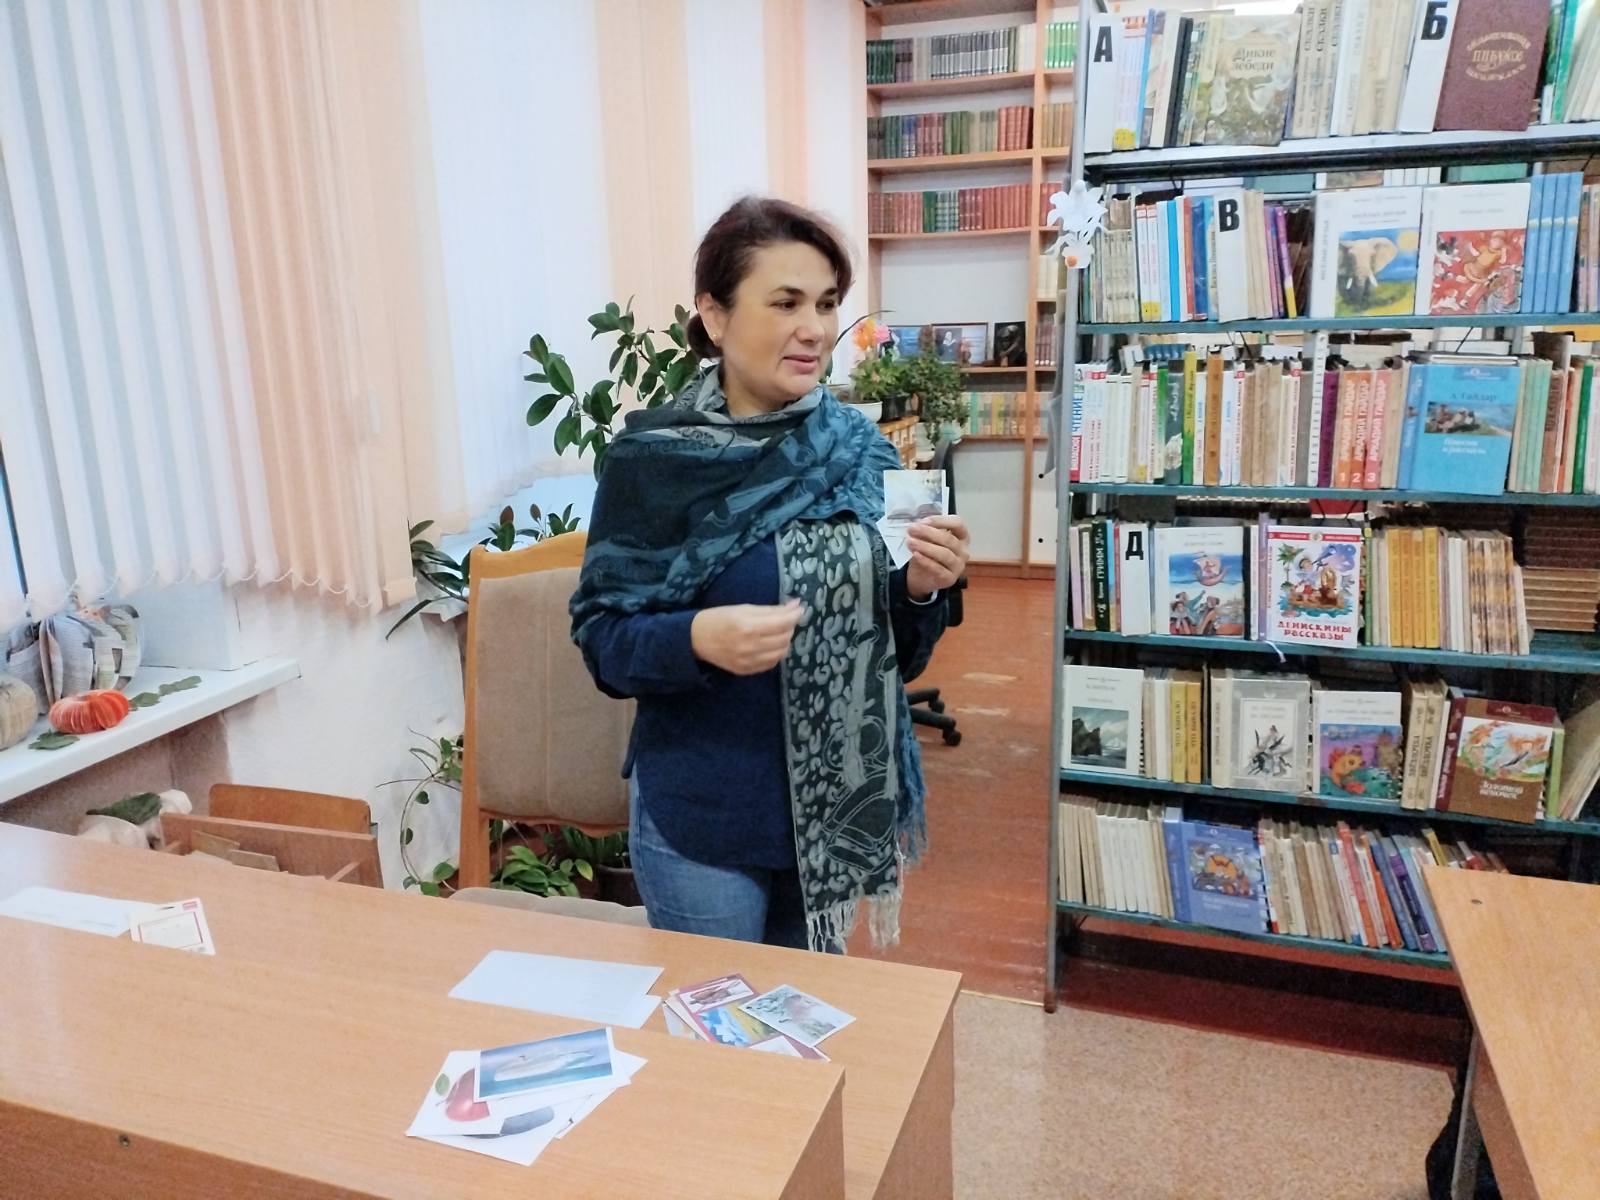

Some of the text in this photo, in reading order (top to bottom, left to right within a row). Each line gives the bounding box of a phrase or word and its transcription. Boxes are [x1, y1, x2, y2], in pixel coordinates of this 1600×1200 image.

[1421, 1, 1448, 40] Б
[1093, 26, 1113, 62] А
[1218, 199, 1240, 232] В
[1072, 397, 1084, 432] ЧТЕНИЕ
[1339, 379, 1356, 461] АРКАДИЙ ГАЙДАР
[1353, 379, 1370, 461] АРКАДИЙ ГАЙДАР
[1369, 379, 1386, 461] АРКАДИЙ ГАЙДАР
[1352, 472, 1361, 483] 2
[1367, 472, 1376, 482] 3
[1125, 531, 1144, 560] Д
[1096, 547, 1105, 579] ГРИММ
[1277, 621, 1352, 633] ДЕНИСКИНЫ
